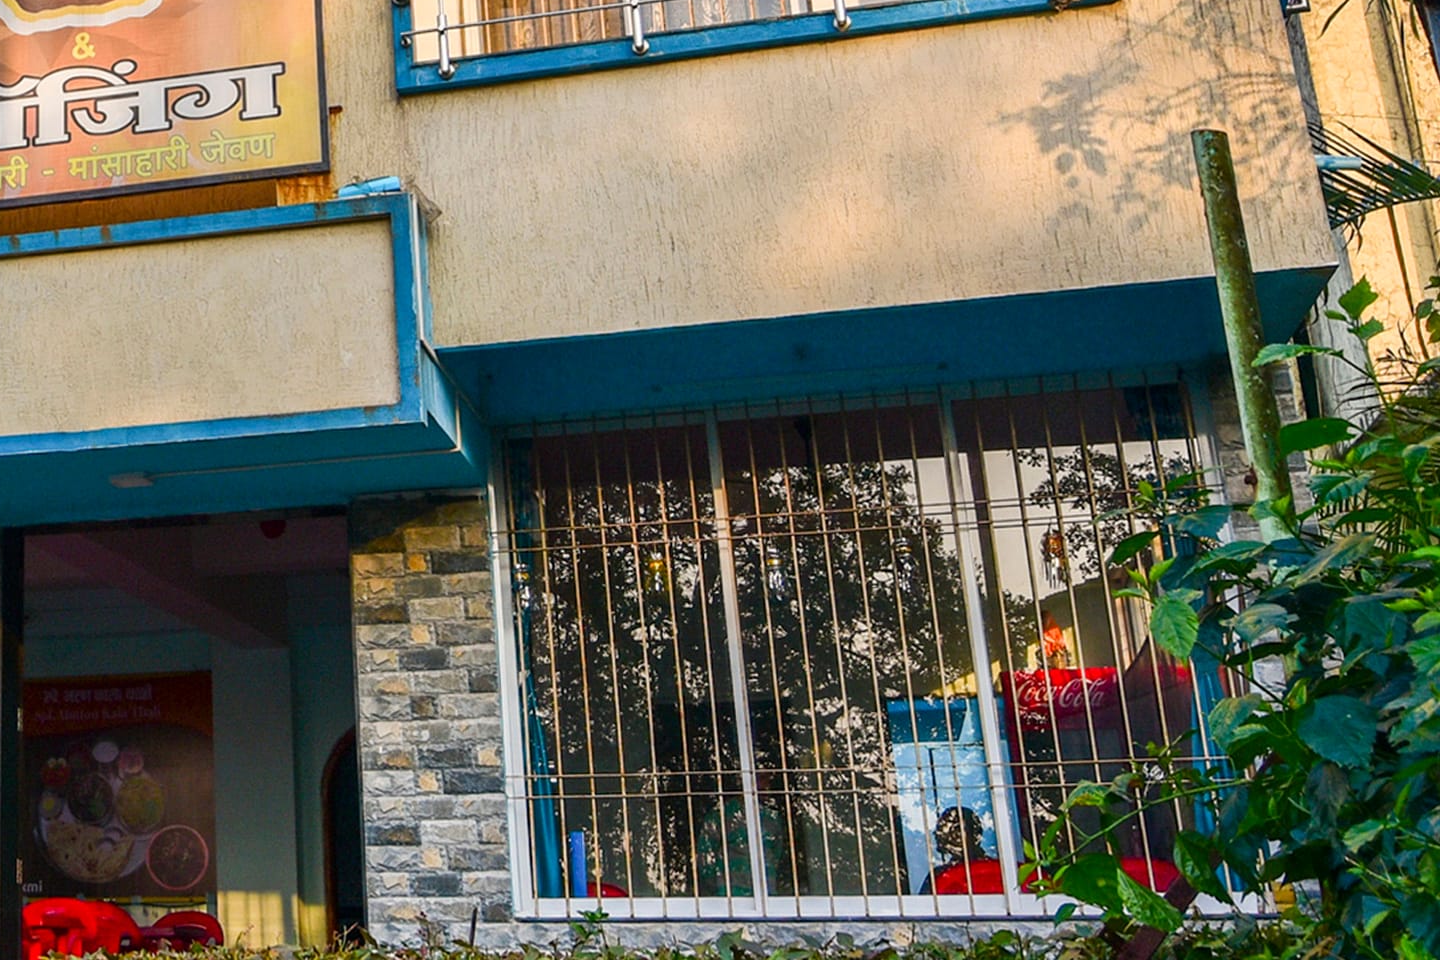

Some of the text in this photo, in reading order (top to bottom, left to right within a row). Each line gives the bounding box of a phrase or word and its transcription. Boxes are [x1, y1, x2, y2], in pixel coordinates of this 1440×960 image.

[71, 32, 97, 60] &
[68, 135, 189, 180] मांसाहारी
[200, 130, 276, 164] जेवण
